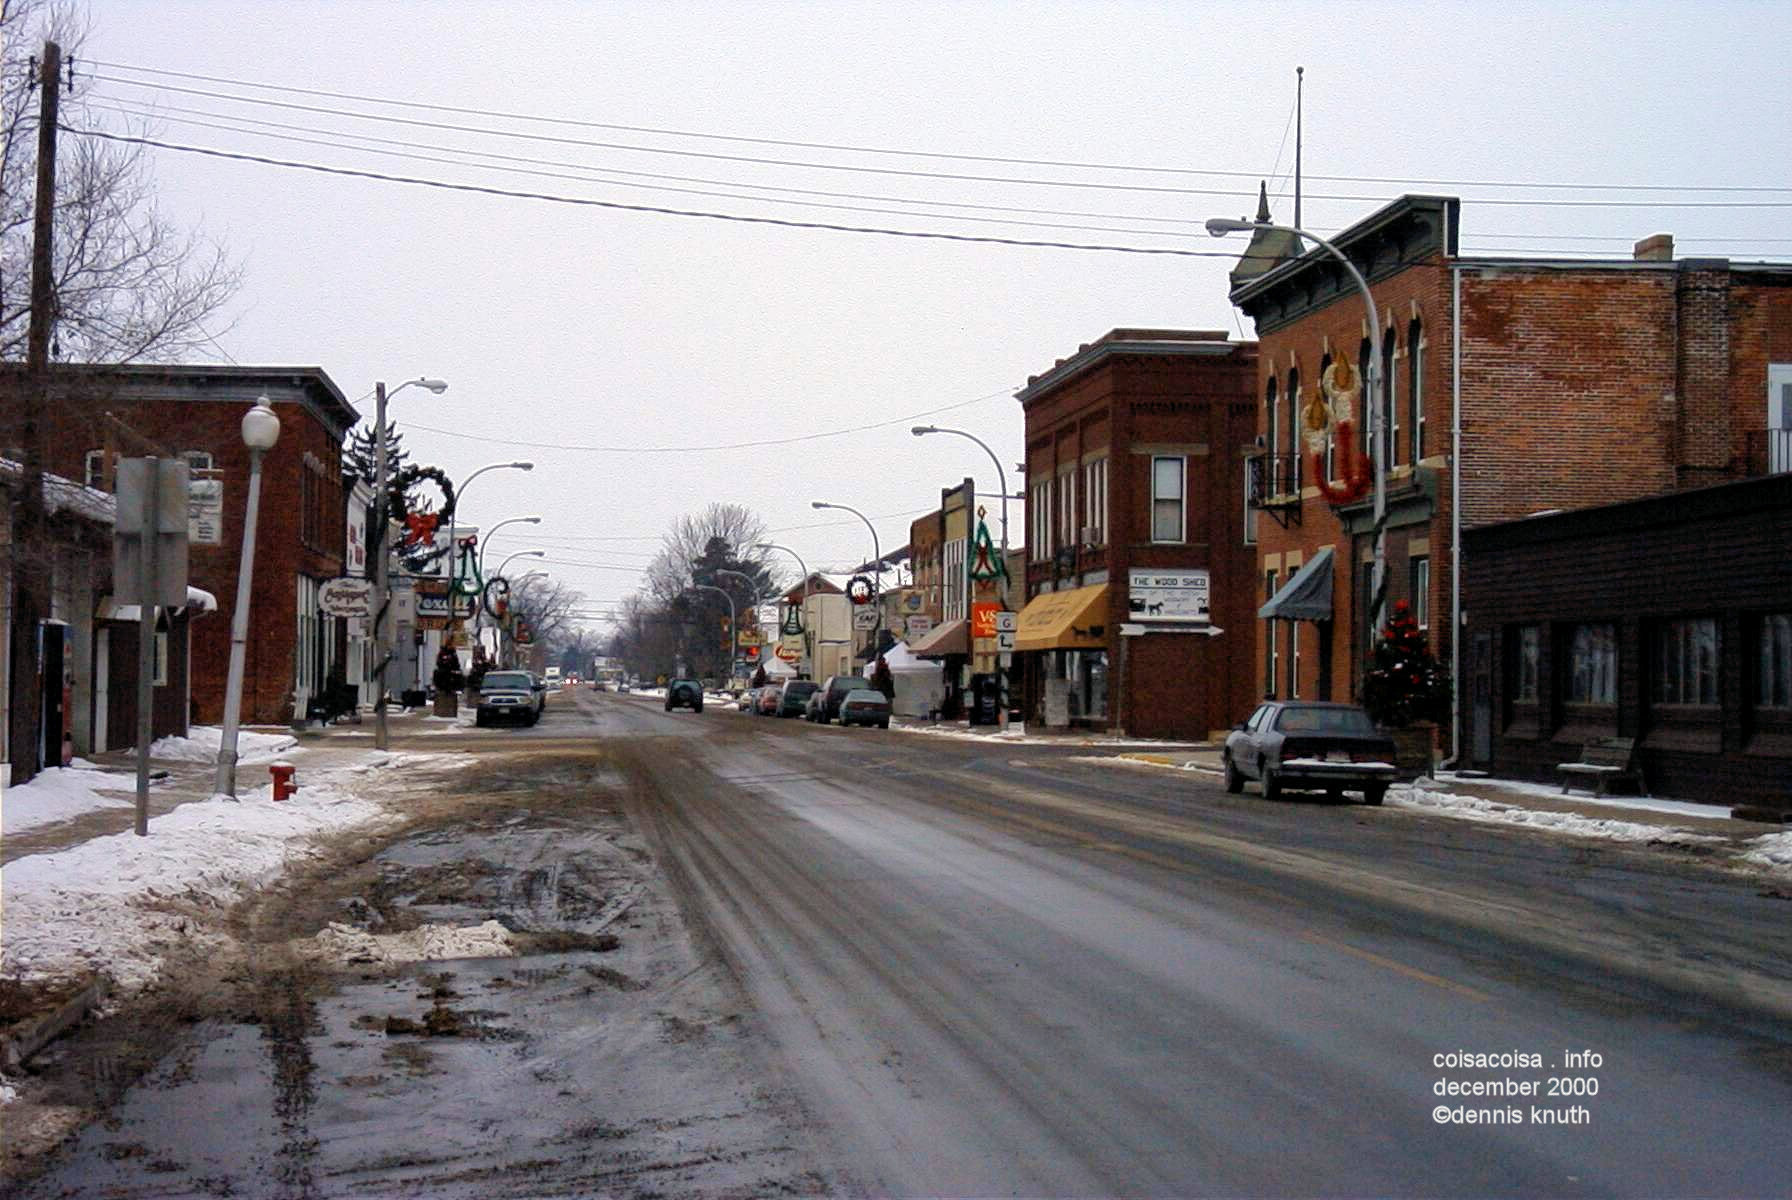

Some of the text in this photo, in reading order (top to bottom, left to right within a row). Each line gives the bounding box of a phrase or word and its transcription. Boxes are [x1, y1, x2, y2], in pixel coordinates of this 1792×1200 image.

[1134, 577, 1206, 586] THE WOOD SHED
